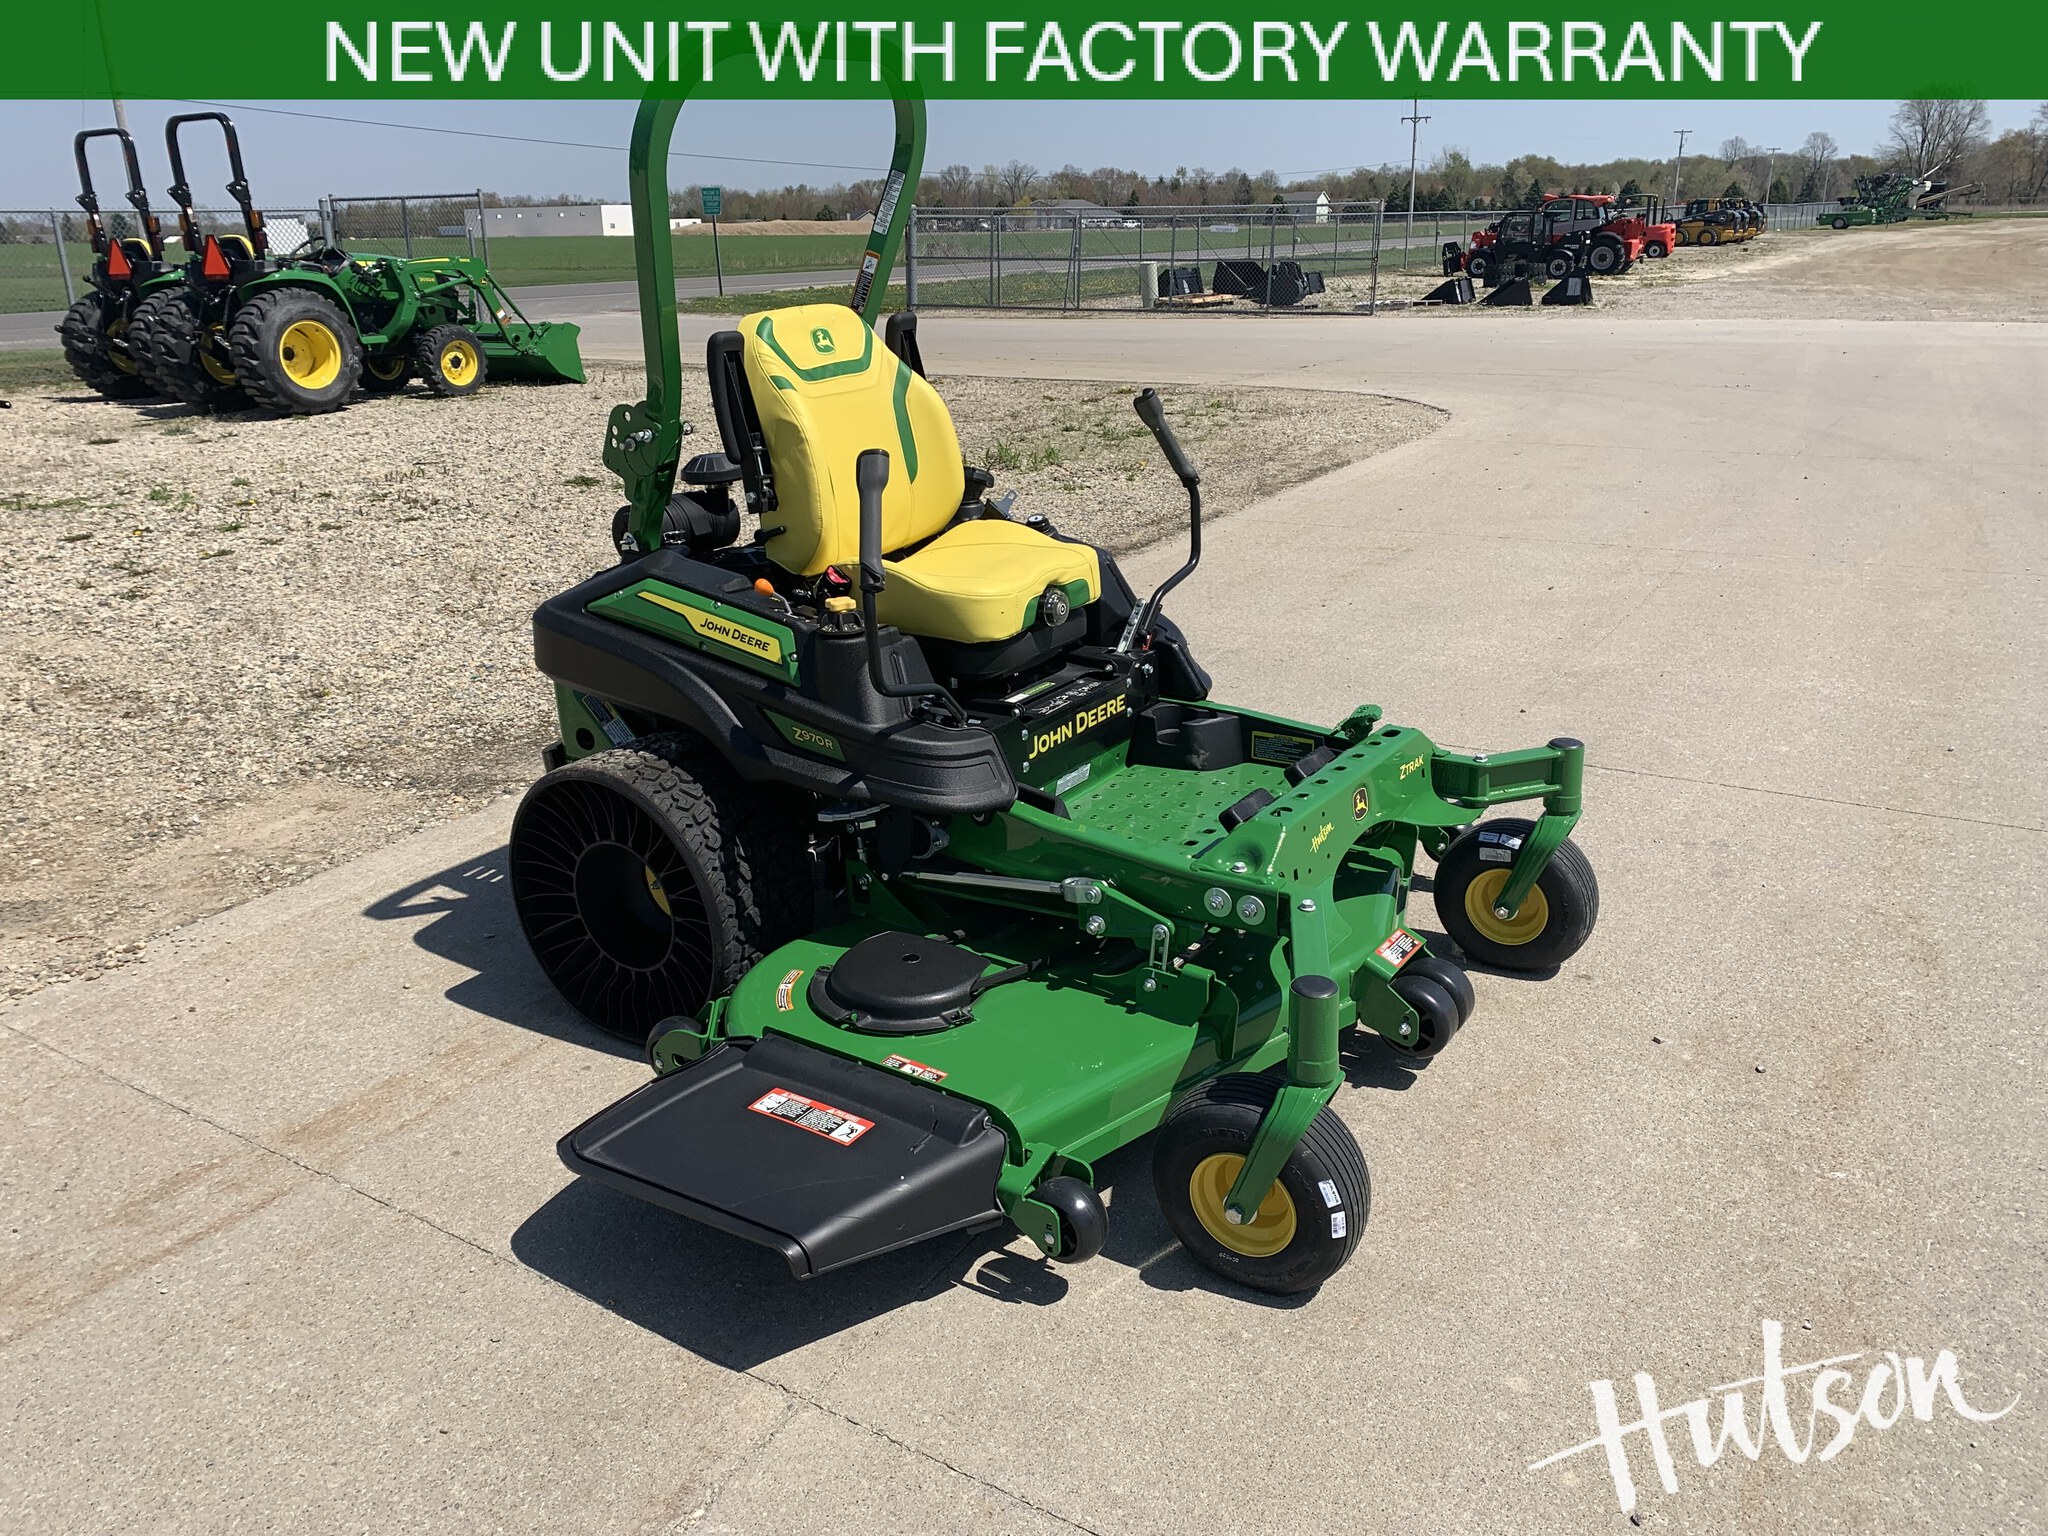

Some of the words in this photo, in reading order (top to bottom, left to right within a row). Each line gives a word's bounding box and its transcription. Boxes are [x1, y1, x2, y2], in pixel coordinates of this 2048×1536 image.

[700, 618, 731, 636] JOHN
[731, 629, 770, 652] DEERE
[792, 726, 834, 750] Z970R
[1028, 721, 1073, 760] JOHN
[1076, 693, 1126, 735] DEERE
[1399, 753, 1425, 781] ZTRAK
[1309, 822, 1336, 854] Hutson
